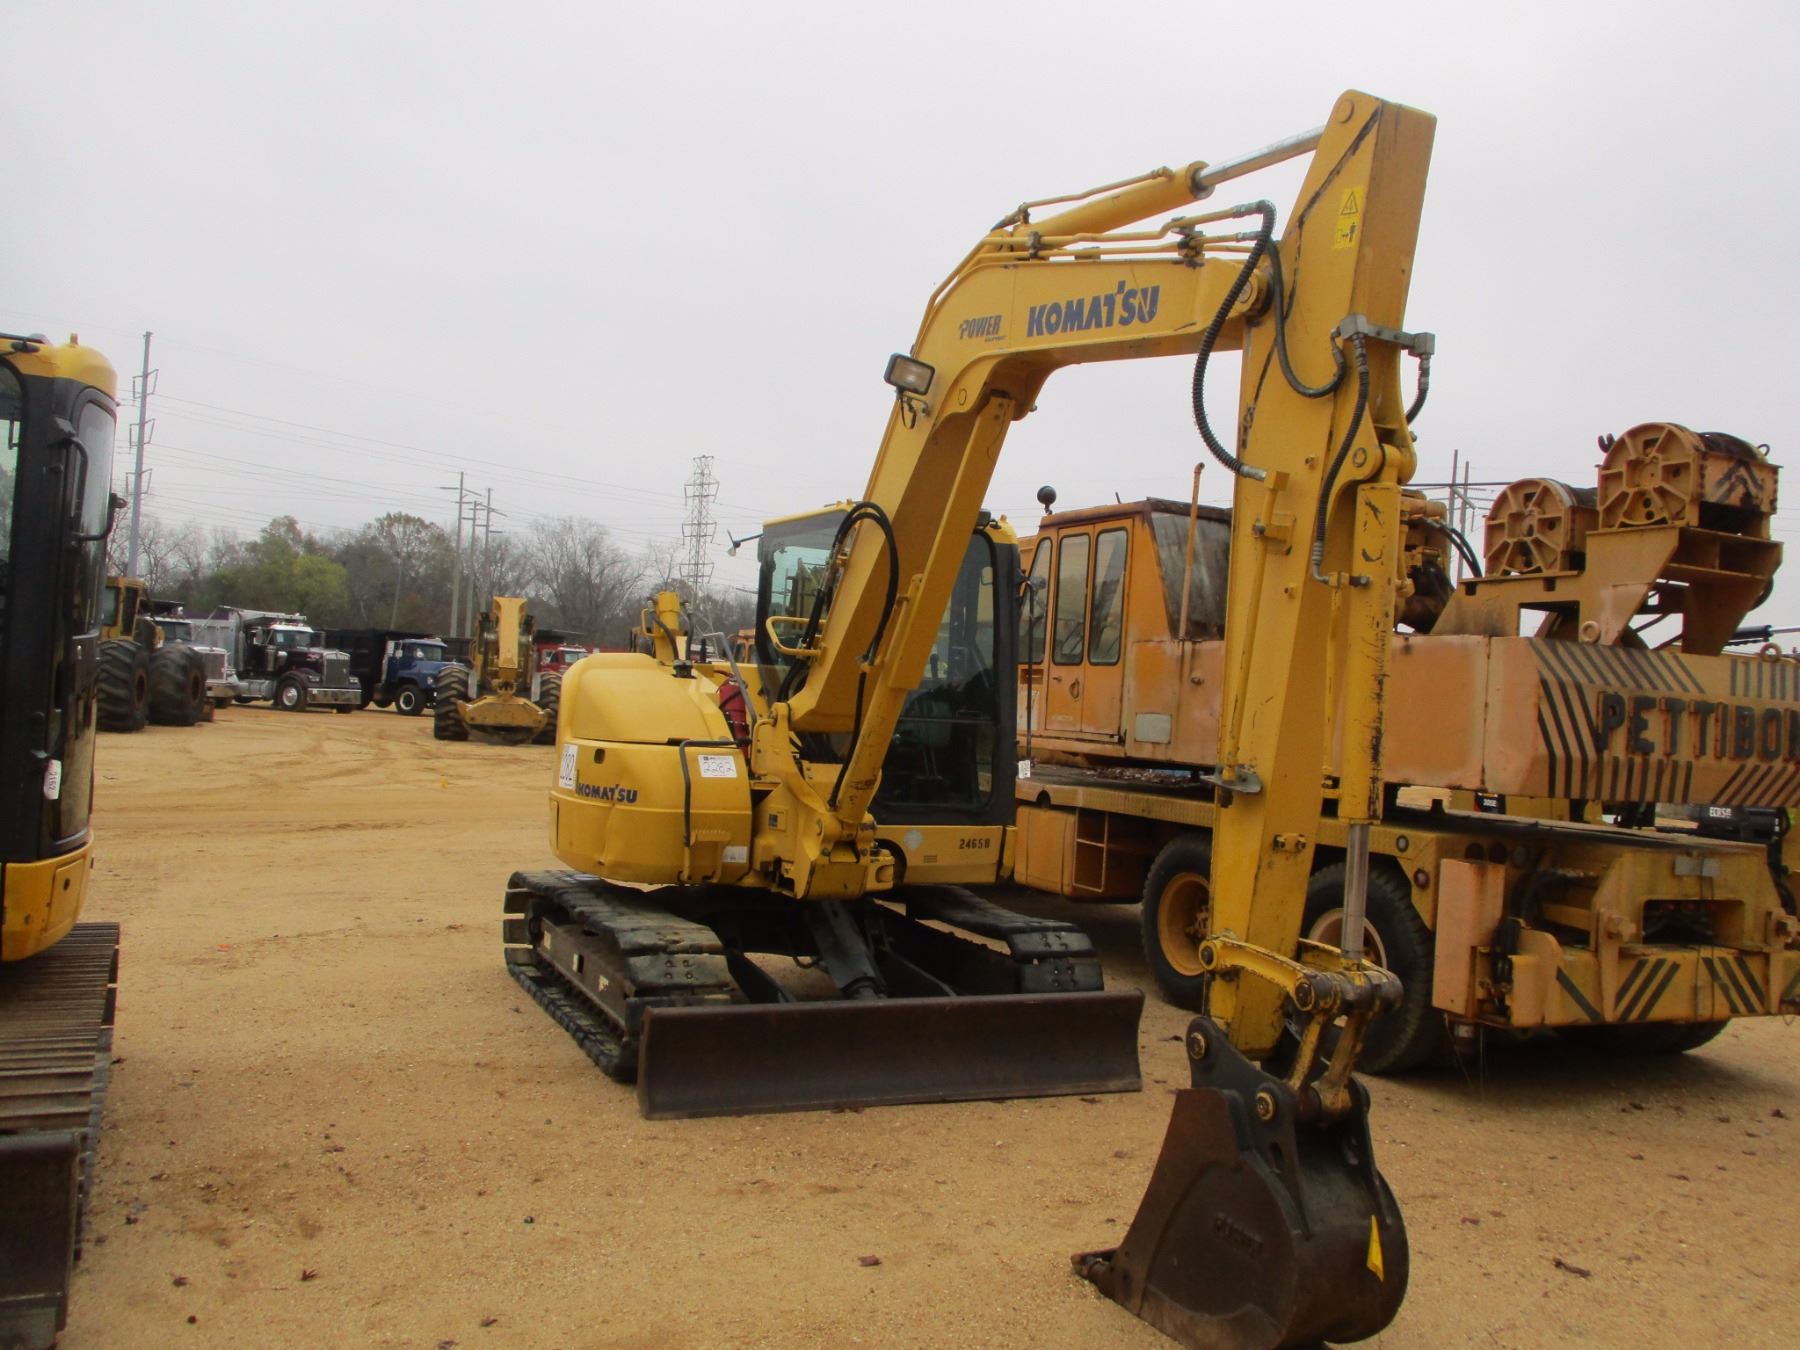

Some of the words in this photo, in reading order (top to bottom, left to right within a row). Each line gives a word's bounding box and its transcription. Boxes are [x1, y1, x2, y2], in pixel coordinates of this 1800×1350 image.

[1027, 280, 1160, 337] KOMATSU
[959, 314, 1003, 340] POWER
[576, 783, 638, 804] KOMATSU
